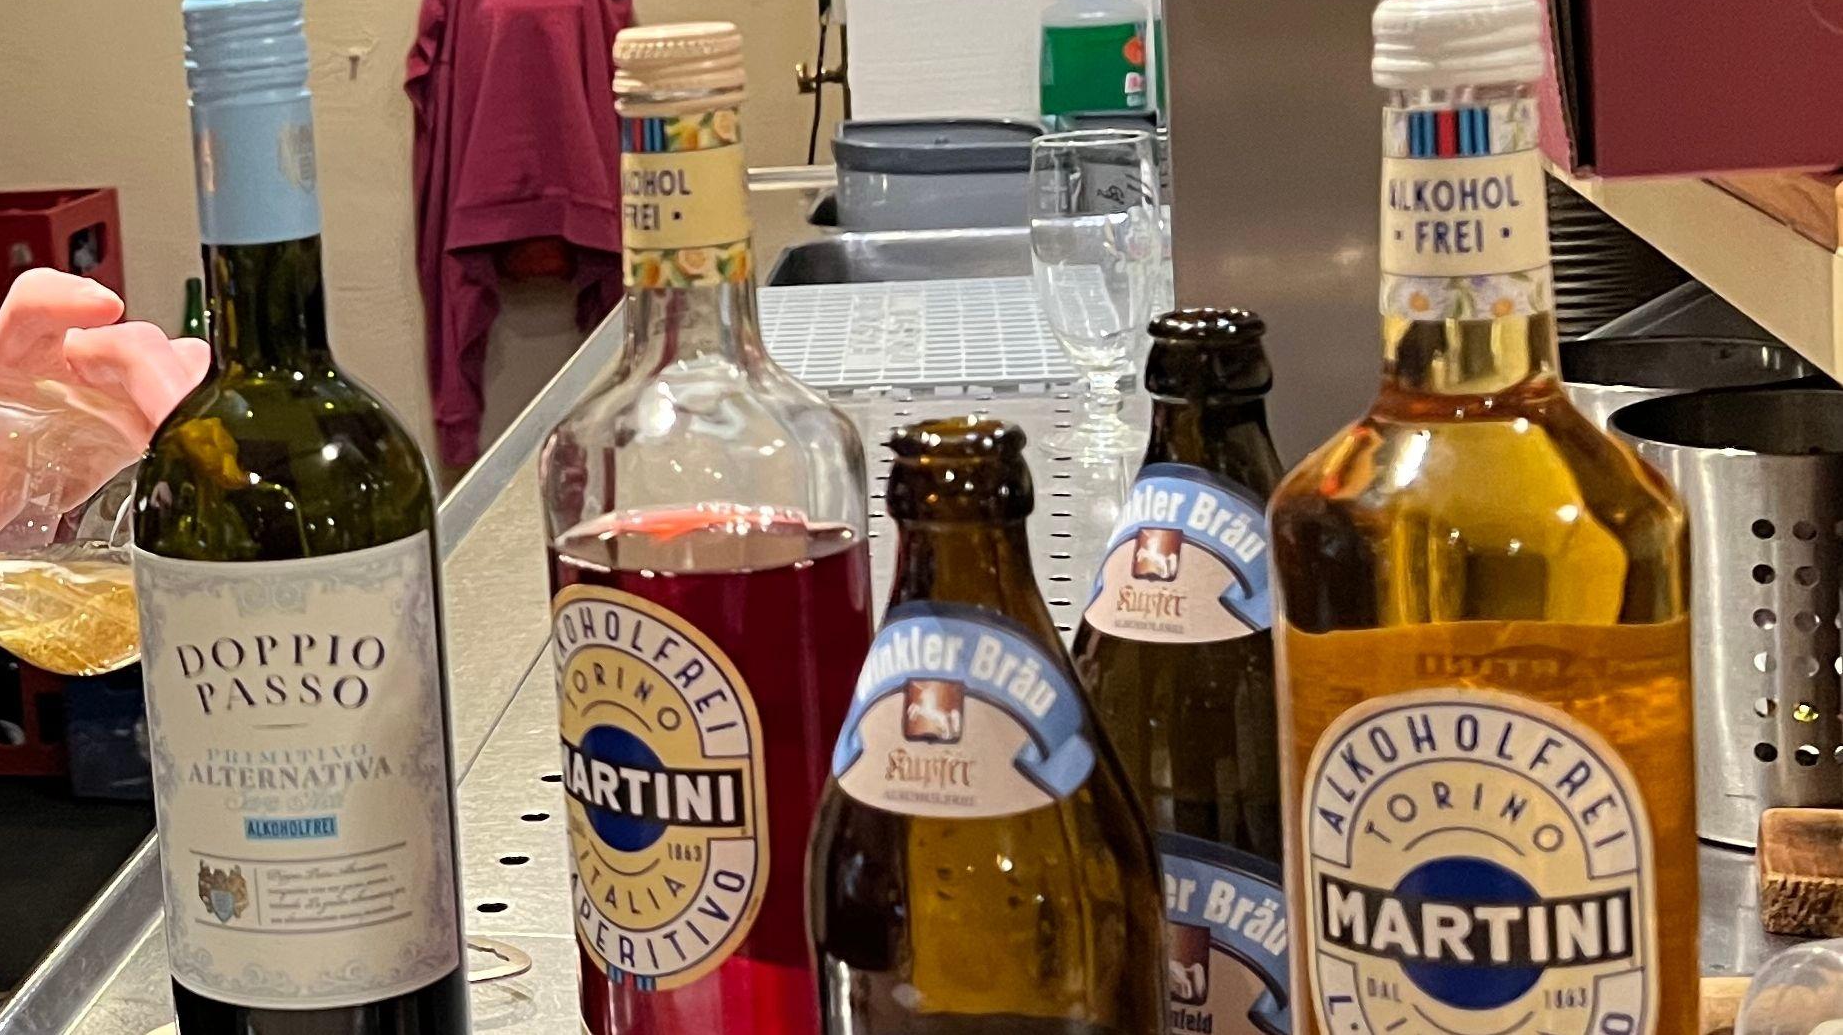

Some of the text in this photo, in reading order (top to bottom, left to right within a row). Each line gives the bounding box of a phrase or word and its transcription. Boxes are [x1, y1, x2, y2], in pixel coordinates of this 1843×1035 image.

[1389, 175, 1521, 213] ALKOHOL
[1414, 219, 1485, 255] FREI
[1187, 491, 1267, 564] Bräu
[176, 633, 386, 679] DOPPIO
[969, 631, 1057, 719] Bräu
[195, 672, 370, 716] PASSO
[188, 756, 394, 790] ALTERNATIVA
[207, 743, 367, 765] PRIMITIVO
[1318, 713, 1627, 849] ALKOHOLFREI
[246, 816, 337, 839] ALKOHOLFREI
[1364, 780, 1565, 853] TORINO
[667, 841, 703, 863] 1863
[579, 849, 687, 915] ITALIA
[1325, 881, 1627, 963] MARTINI
[1366, 976, 1402, 1003] DAL
[1542, 986, 1589, 1011] 1863
